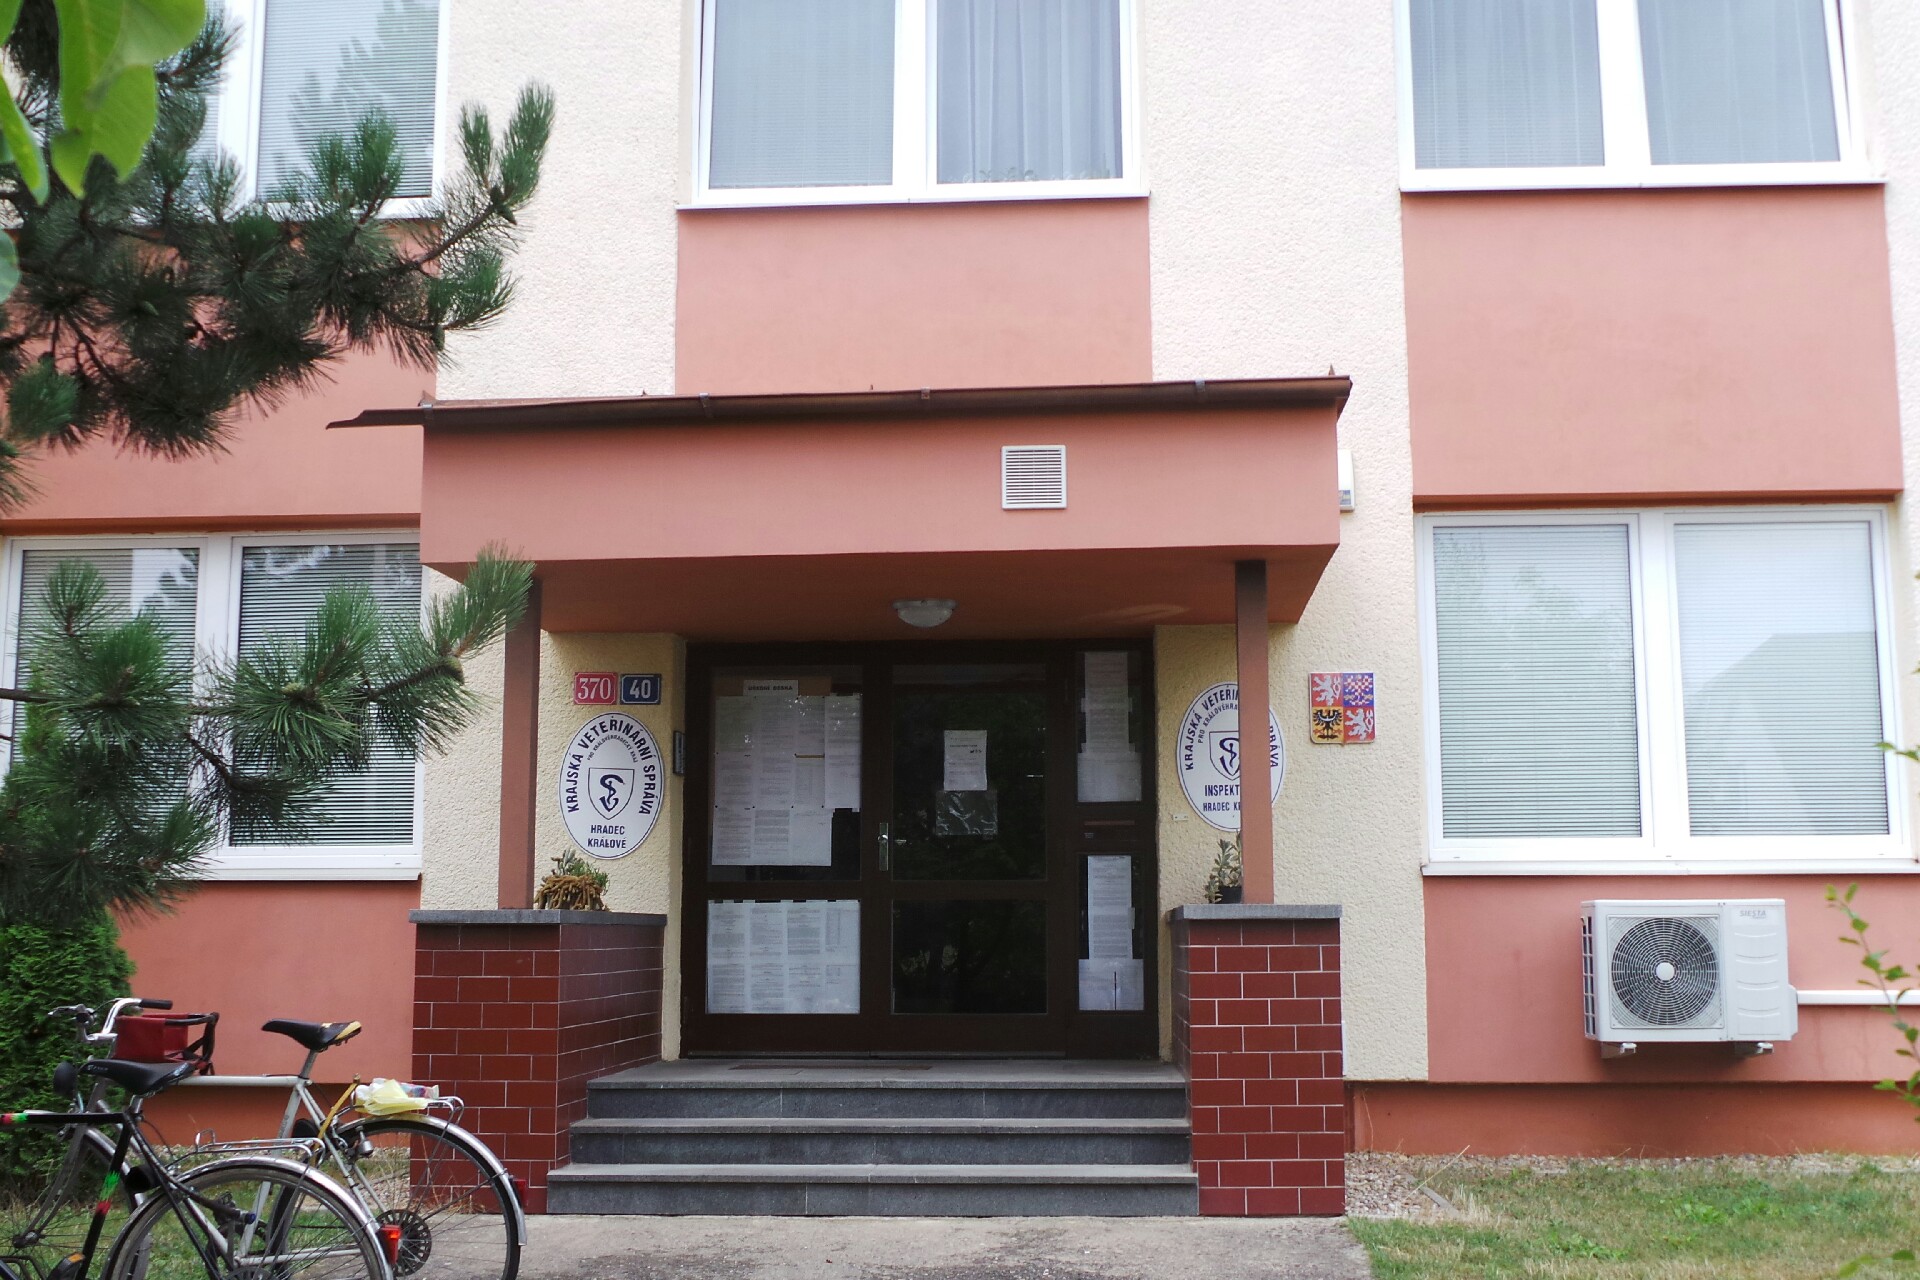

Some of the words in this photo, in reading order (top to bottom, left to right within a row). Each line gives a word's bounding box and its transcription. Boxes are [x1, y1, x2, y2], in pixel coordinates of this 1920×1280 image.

[578, 678, 611, 699] 370
[629, 679, 651, 699] 40
[1198, 729, 1206, 744] PRO
[1202, 702, 1239, 727] KRÁLOVÉHRA
[1184, 709, 1203, 771] KRAJSKÁ
[1269, 725, 1280, 768] PRÁVA
[565, 752, 584, 813] KRAJSKÁ
[577, 718, 654, 761] VETERINÁRNÍ
[638, 764, 658, 815] SPRÁVA
[1204, 784, 1241, 797] INSPEKT
[1202, 801, 1231, 812] HRADEC
[590, 824, 626, 835] HRADEC
[587, 836, 627, 849] KRÁLOVÉ
